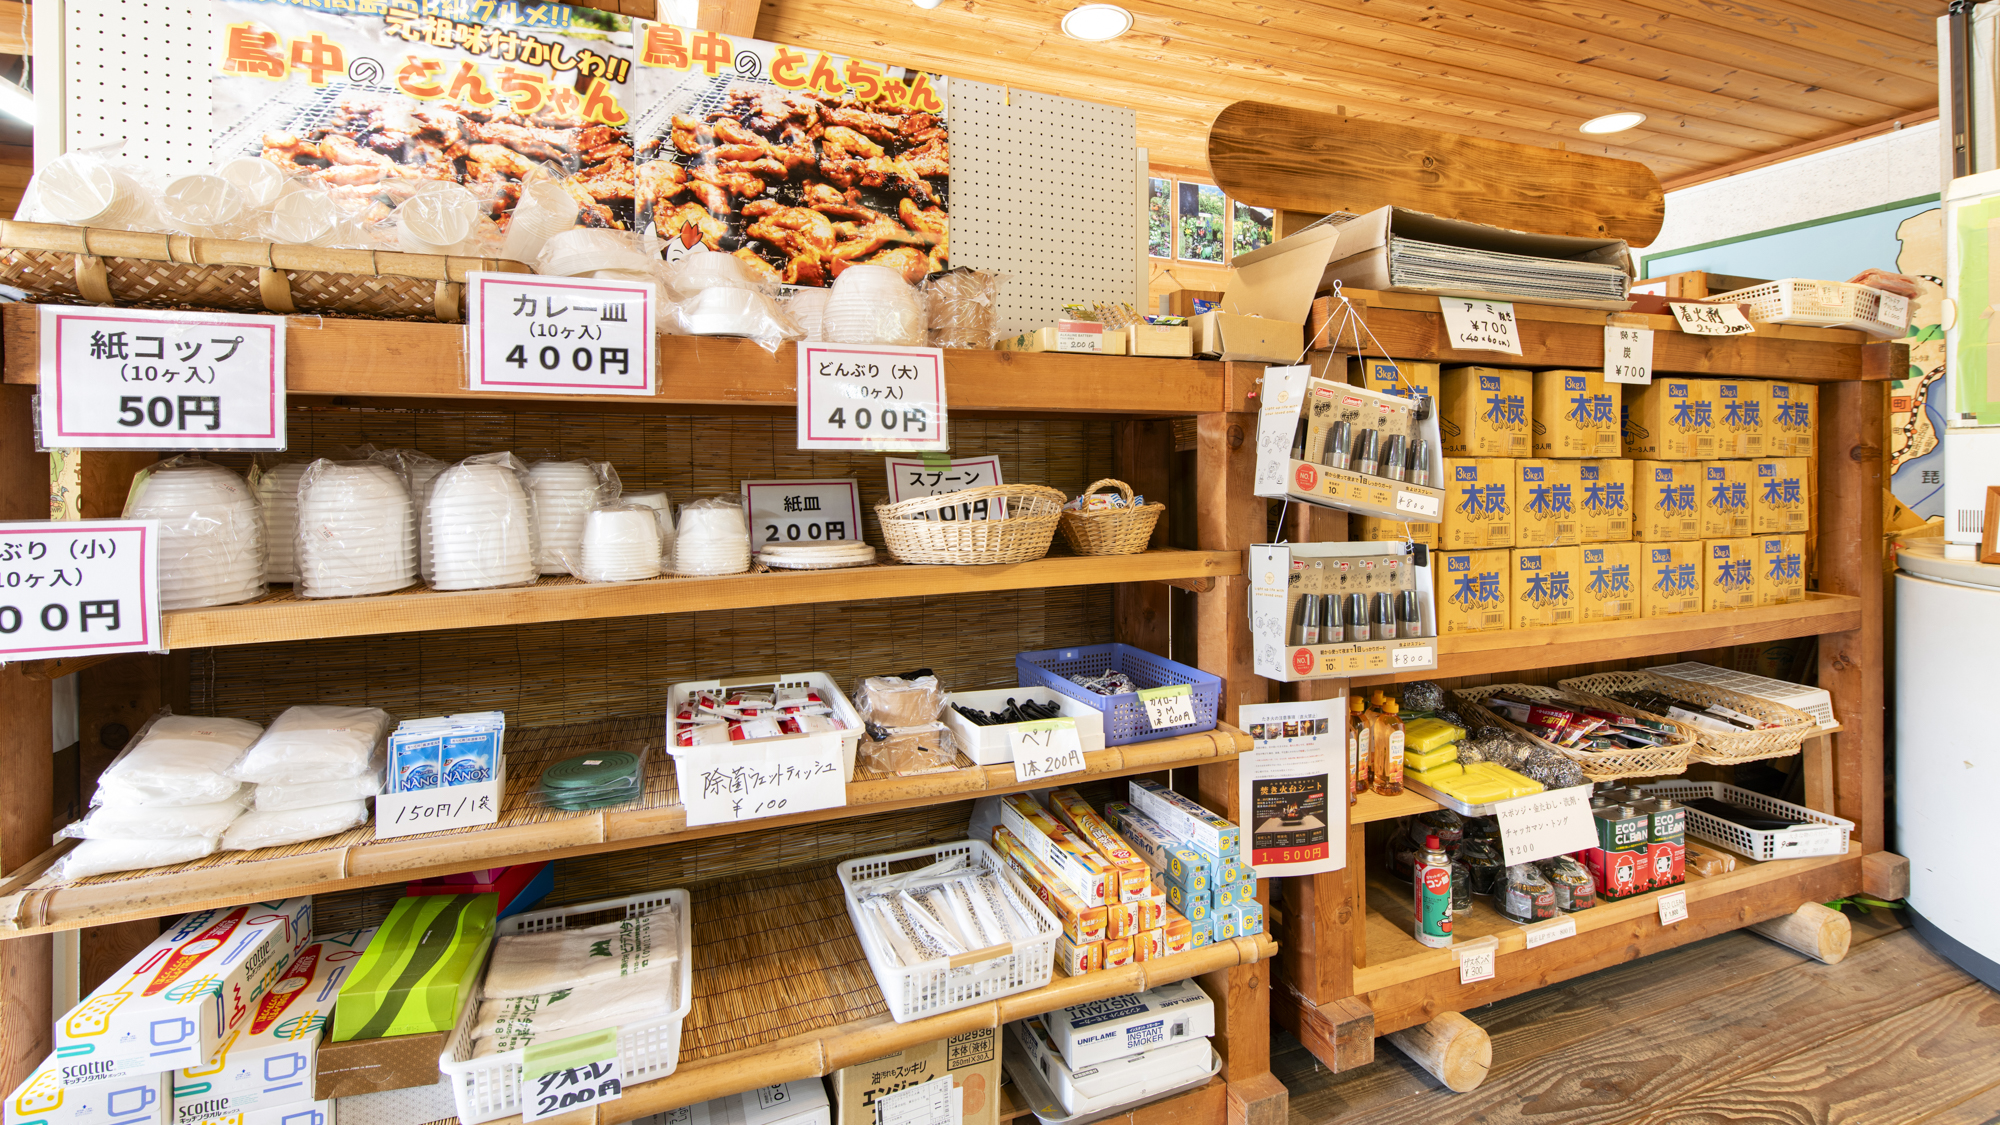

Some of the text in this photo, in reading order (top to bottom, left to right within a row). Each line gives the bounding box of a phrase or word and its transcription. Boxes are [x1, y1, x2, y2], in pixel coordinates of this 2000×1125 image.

[385, 9, 630, 83] 元祖味付かしわ!!
[224, 22, 628, 125] 鳥中のとんちゃん
[642, 24, 944, 113] 鳥中のとんちゃん
[513, 294, 628, 322] カレー皿
[1679, 304, 1725, 325] 着火剤
[1470, 320, 1507, 335] ¥700
[90, 330, 244, 362] 紙コップ
[506, 345, 629, 375] 400円
[1377, 368, 1397, 380] 3kg入
[1615, 365, 1646, 378] ¥700
[1482, 377, 1500, 390] 3kg入
[1566, 377, 1585, 390] 3kg入
[1670, 385, 1688, 397] 3kg入
[1721, 386, 1737, 397] 3kg入
[1774, 386, 1789, 398] 3kg入
[117, 395, 221, 430] 50円
[1487, 394, 1525, 423] 木炭
[1571, 394, 1613, 423] 木炭
[1674, 400, 1712, 427] 木炭
[1725, 400, 1760, 426] 木炭
[1777, 401, 1808, 427] 木炭
[828, 407, 926, 432] 400円
[909, 470, 980, 487] スプーン
[1457, 467, 1477, 481] 3kg入
[1525, 467, 1544, 481] 3kg入
[1581, 466, 1598, 480] 3kg入
[1656, 469, 1672, 482] 3kg入
[1708, 467, 1725, 480] 3kg入
[1759, 465, 1775, 477] 3kg入
[1921, 470, 1940, 484] 琵
[1529, 484, 1571, 512] 木炭
[1584, 482, 1625, 510] 木炭
[1660, 484, 1694, 511] 木炭
[1712, 482, 1746, 508] 木炭
[1764, 478, 1800, 503] 木炭
[784, 495, 821, 512] 紙皿
[1461, 484, 1505, 514] 木炭
[765, 521, 846, 542] 200円
[1714, 546, 1730, 558] 3kg入
[1766, 541, 1781, 552] 3kg入
[1522, 556, 1541, 570] 3kg入
[1585, 550, 1603, 563] 3kg入
[1653, 549, 1671, 562] 3kg入
[1449, 557, 1469, 571] 3kg入
[1770, 554, 1800, 580] 木炭
[1590, 564, 1630, 593] 木炭
[1658, 564, 1695, 592] 木炭
[1718, 560, 1751, 586] 木炭
[1455, 572, 1500, 604] 木炭
[1527, 571, 1569, 601] 木炭
[1394, 654, 1423, 665] ¥800
[1169, 710, 1191, 724] 600円
[1023, 749, 1080, 776] 1本 200円
[443, 768, 490, 783] NANOX
[1260, 781, 1322, 796] 焚き火台シート
[1615, 822, 1636, 834] ECO
[1654, 814, 1674, 826] ECO
[1654, 821, 1685, 836] CLEAN
[1615, 829, 1648, 845] CLEAN
[1509, 843, 1534, 856] ¥200
[245, 941, 270, 975] scottie
[1159, 995, 1205, 1009] UNIFLAME
[1077, 1031, 1117, 1046] UNIFLAME
[1127, 1027, 1163, 1041] INSTANT
[1127, 1034, 1163, 1049] SMOKER
[62, 1059, 114, 1079] scottie
[871, 1060, 927, 1085] 油汚れもスッキリ
[63, 1074, 107, 1085] キッチンタオル
[536, 1062, 613, 1096] タオル
[536, 1078, 621, 1116] 200円
[178, 1098, 229, 1118] scottie
[180, 1111, 222, 1124] キッチンタオル
